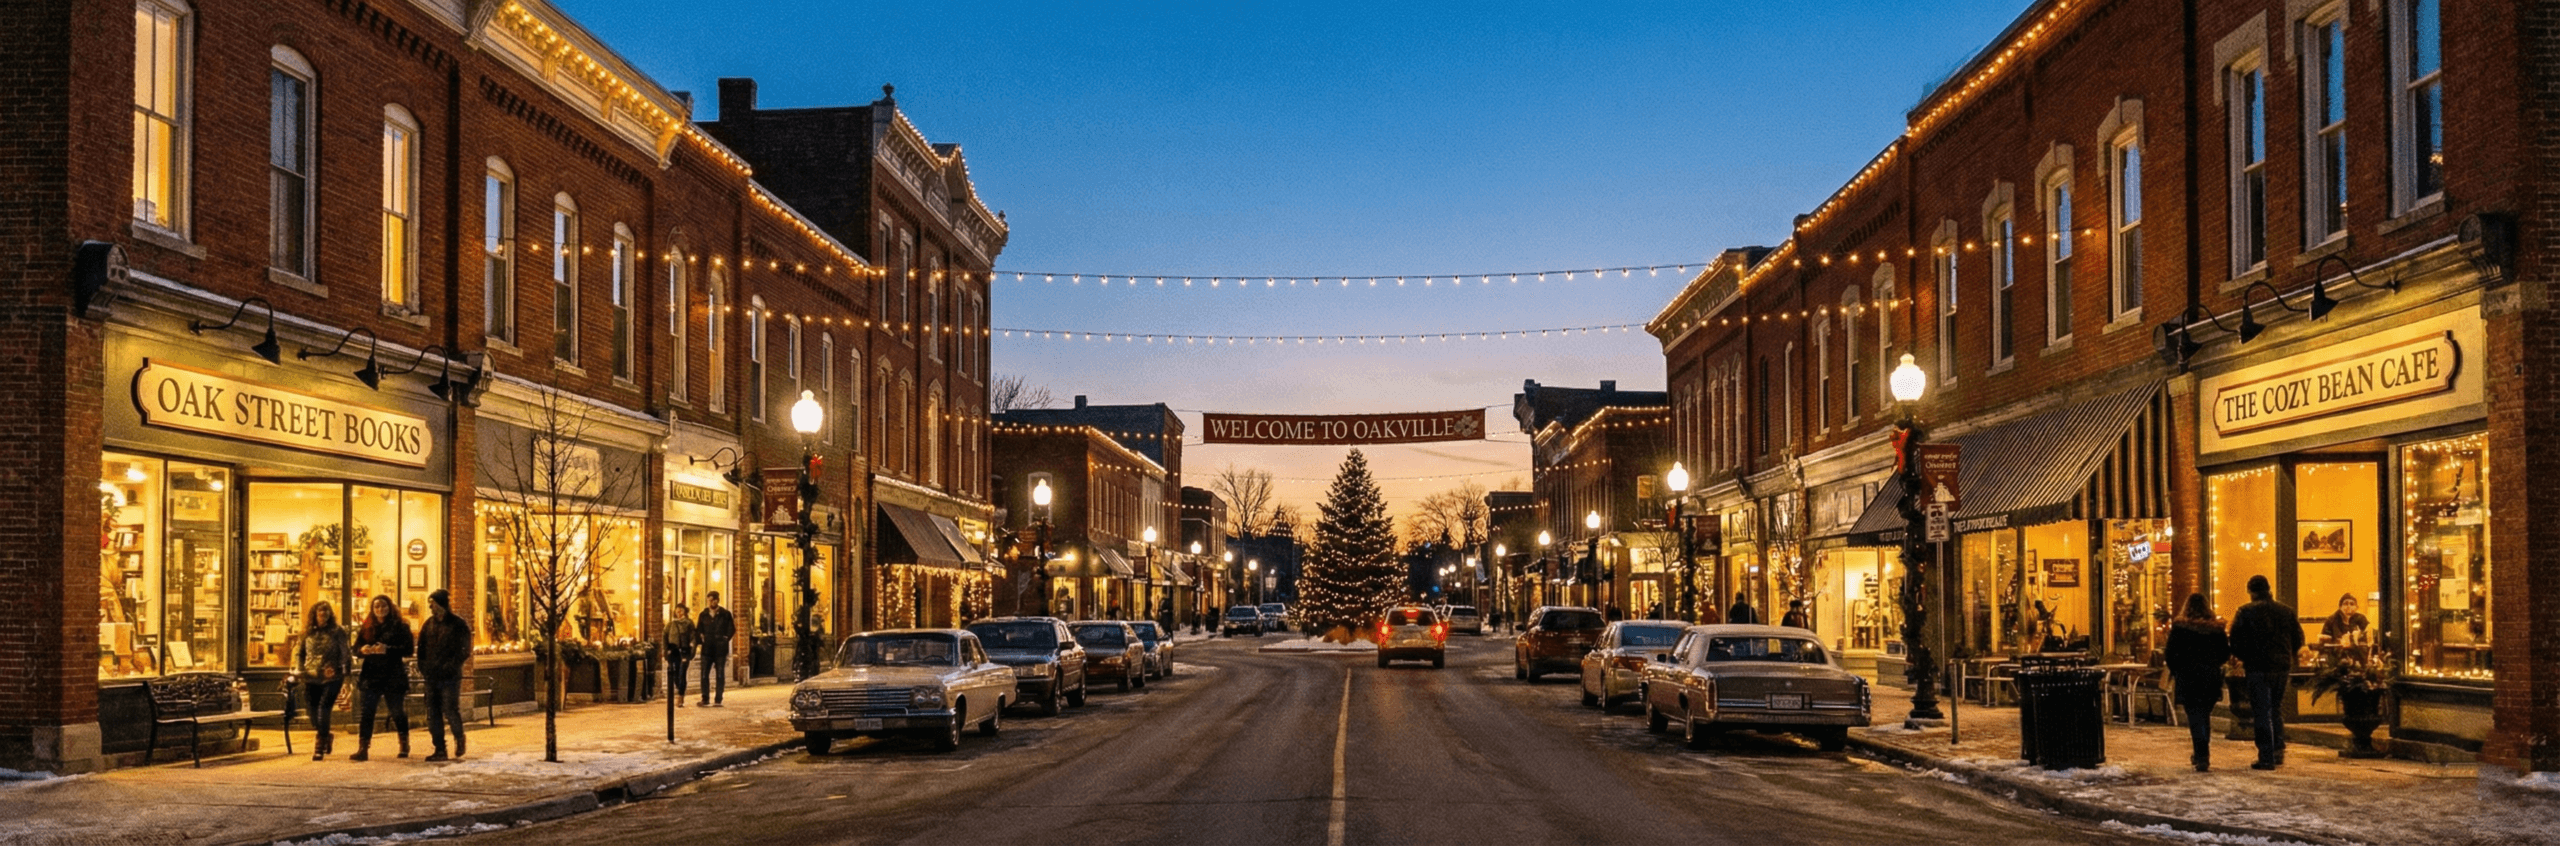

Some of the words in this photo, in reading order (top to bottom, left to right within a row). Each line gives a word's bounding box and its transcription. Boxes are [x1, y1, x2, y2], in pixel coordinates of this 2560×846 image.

[157, 377, 225, 422] OAK
[235, 391, 336, 441] STREET
[343, 412, 421, 455] BOOKS
[2223, 391, 2259, 423] THE
[2262, 378, 2312, 415] COZY
[2317, 362, 2375, 403] BEAN
[2380, 347, 2440, 389] CAFE
[1210, 419, 1316, 440] WELCOME
[1320, 420, 1348, 440] TO
[1353, 417, 1455, 440] OAKVILLE
